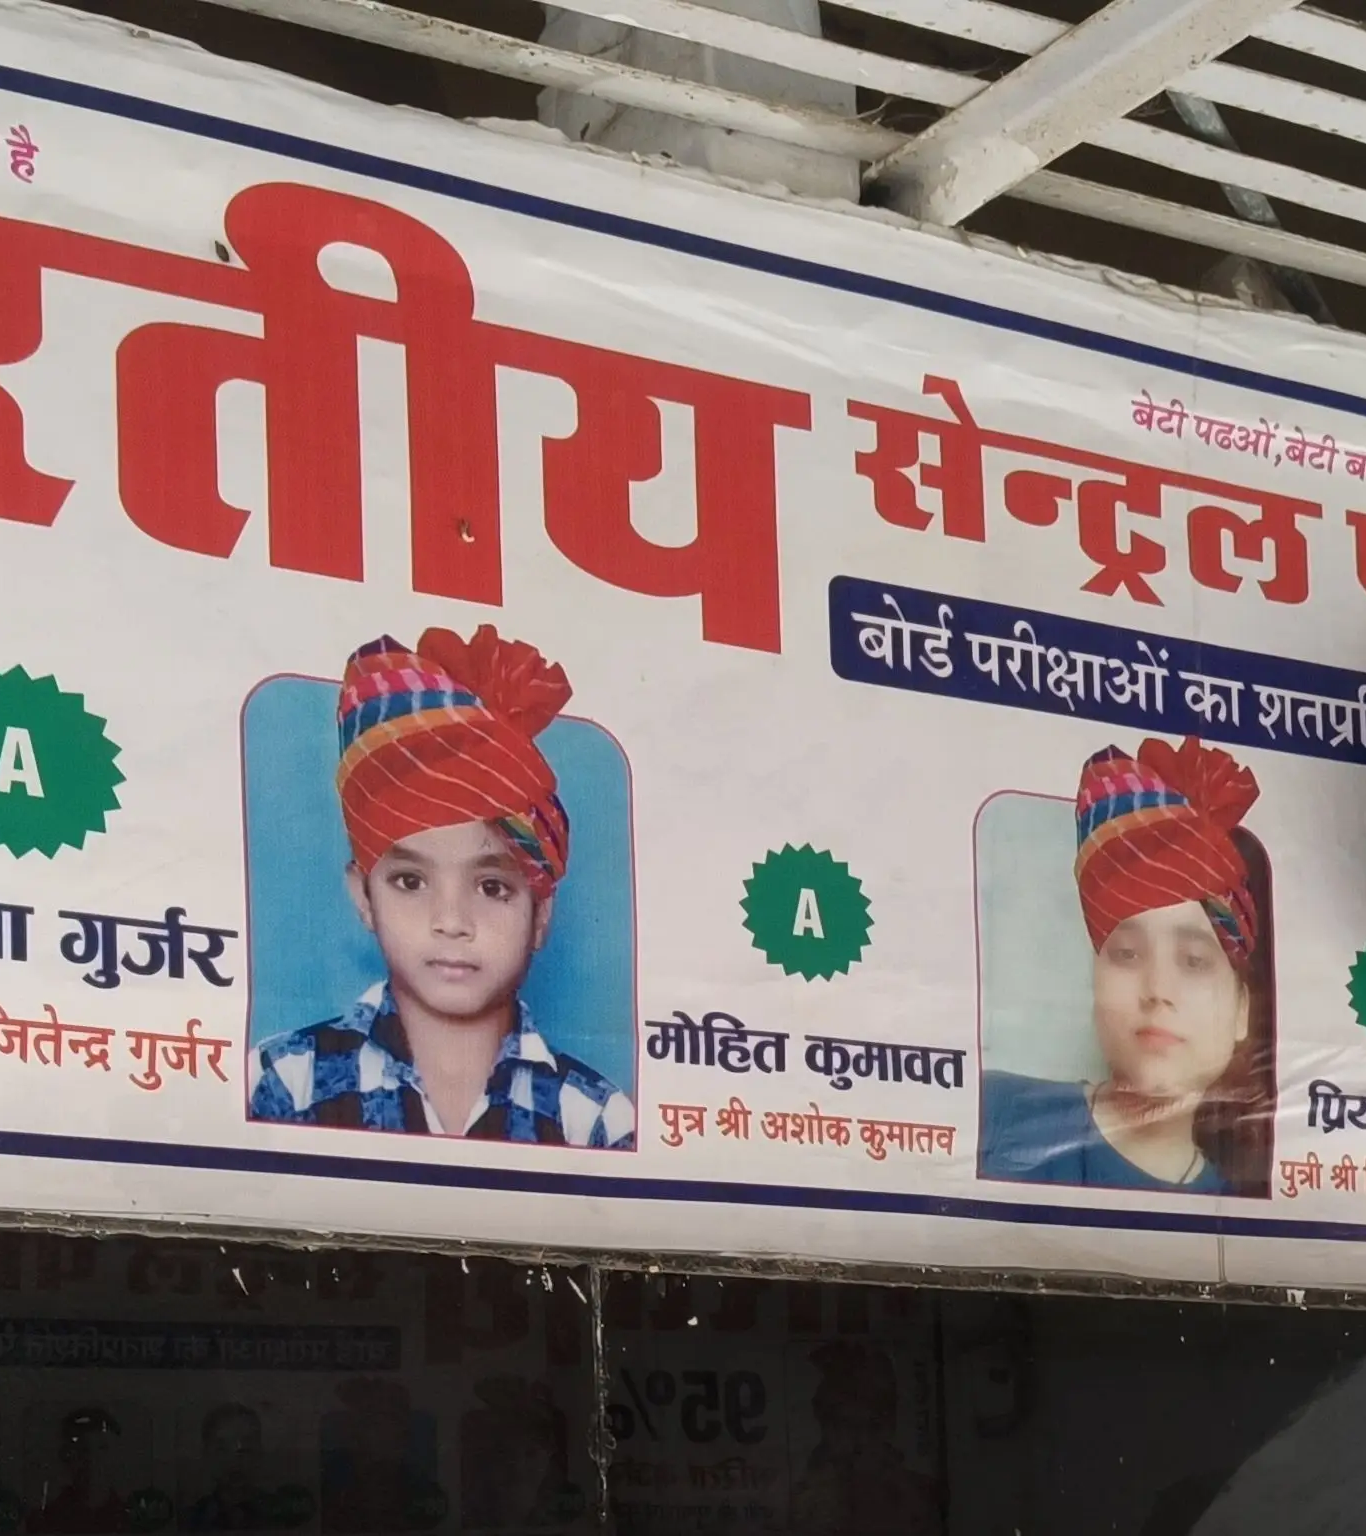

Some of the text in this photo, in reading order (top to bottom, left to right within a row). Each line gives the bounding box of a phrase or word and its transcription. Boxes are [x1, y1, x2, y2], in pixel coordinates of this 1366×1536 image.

[6, 125, 40, 183] है
[1131, 388, 1188, 438] बेटी
[847, 374, 1323, 607] सेन्ट्रल
[850, 592, 955, 681] बोर्ड
[964, 620, 1171, 714] परीक्षाओं
[1182, 669, 1246, 728] का
[792, 887, 825, 939] A
[58, 906, 239, 990] गुर्जर
[125, 1018, 232, 1091] गुर्जर
[644, 1010, 967, 1091] मोहित कुमावत
[658, 1096, 957, 1162] पुत्र श्री अशोक कुमातव
[1279, 1151, 1323, 1199] पुत्री
[1330, 1155, 1358, 1193] श्री
